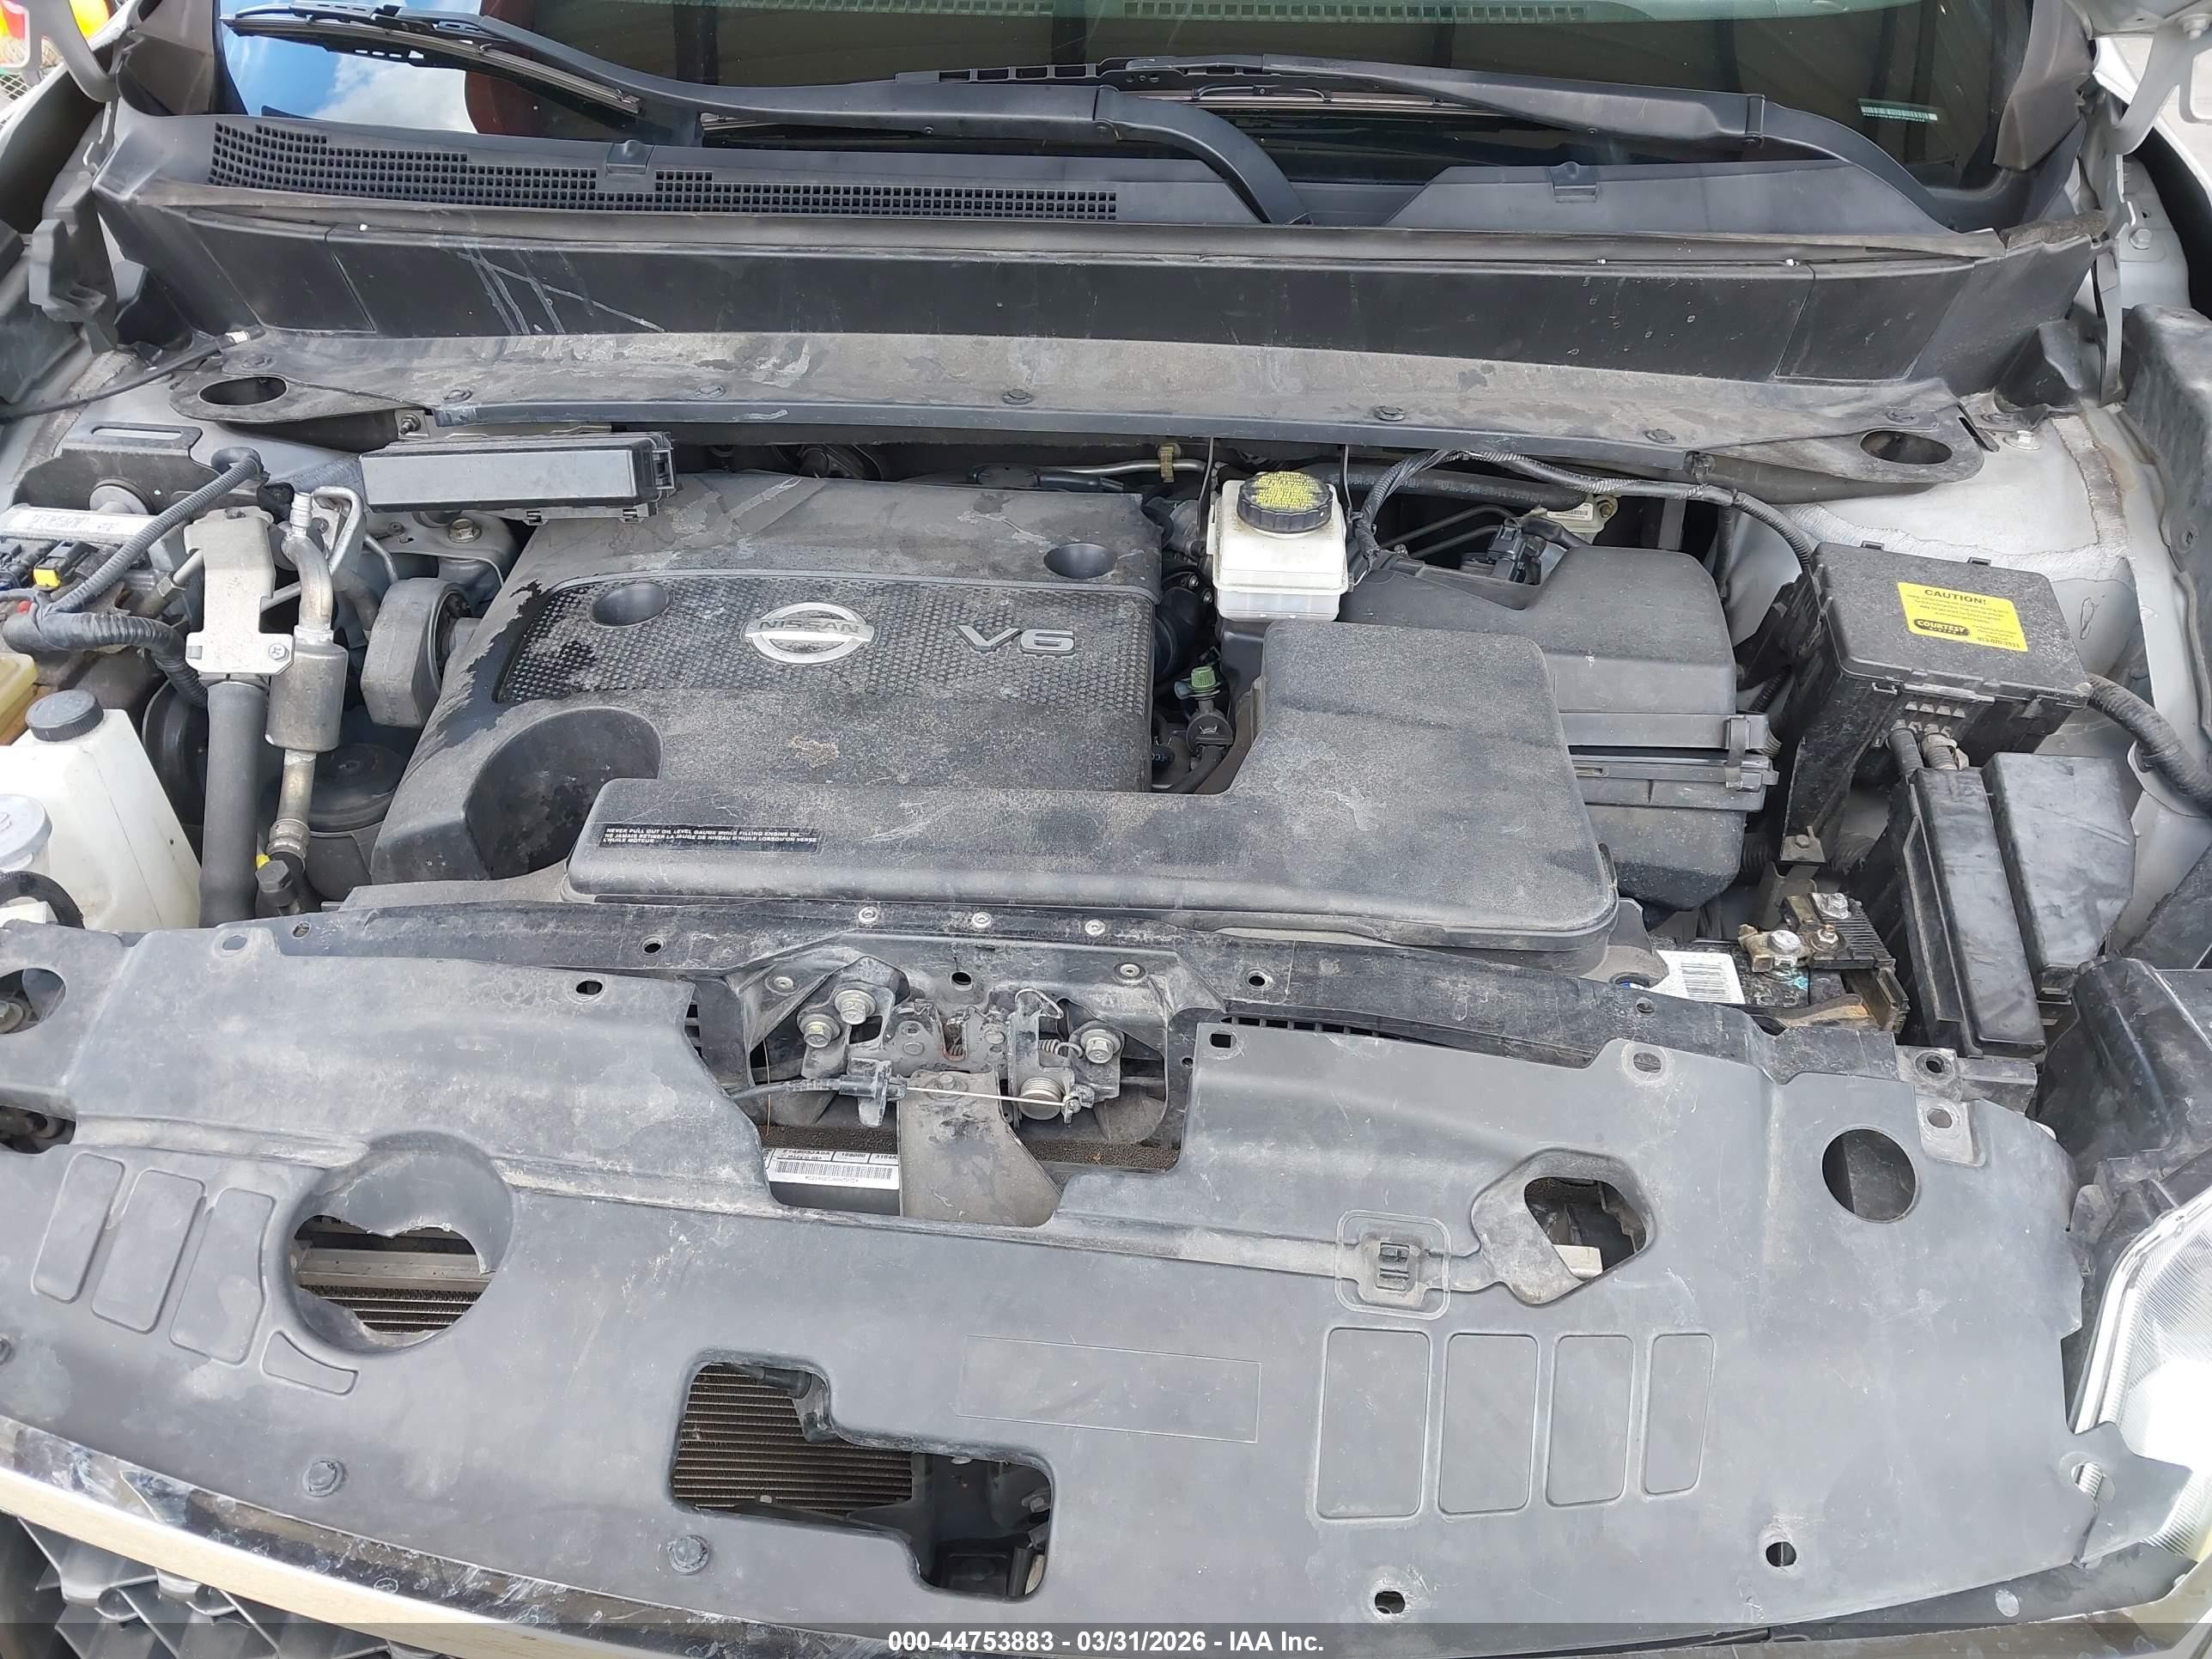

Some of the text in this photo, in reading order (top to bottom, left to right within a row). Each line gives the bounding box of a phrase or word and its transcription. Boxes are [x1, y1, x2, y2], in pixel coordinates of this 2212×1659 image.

[1924, 589, 1985, 605] CAUTION!
[759, 619, 860, 634] NISSAN
[1917, 620, 1965, 632] COURTESY
[955, 624, 1075, 655] V6
